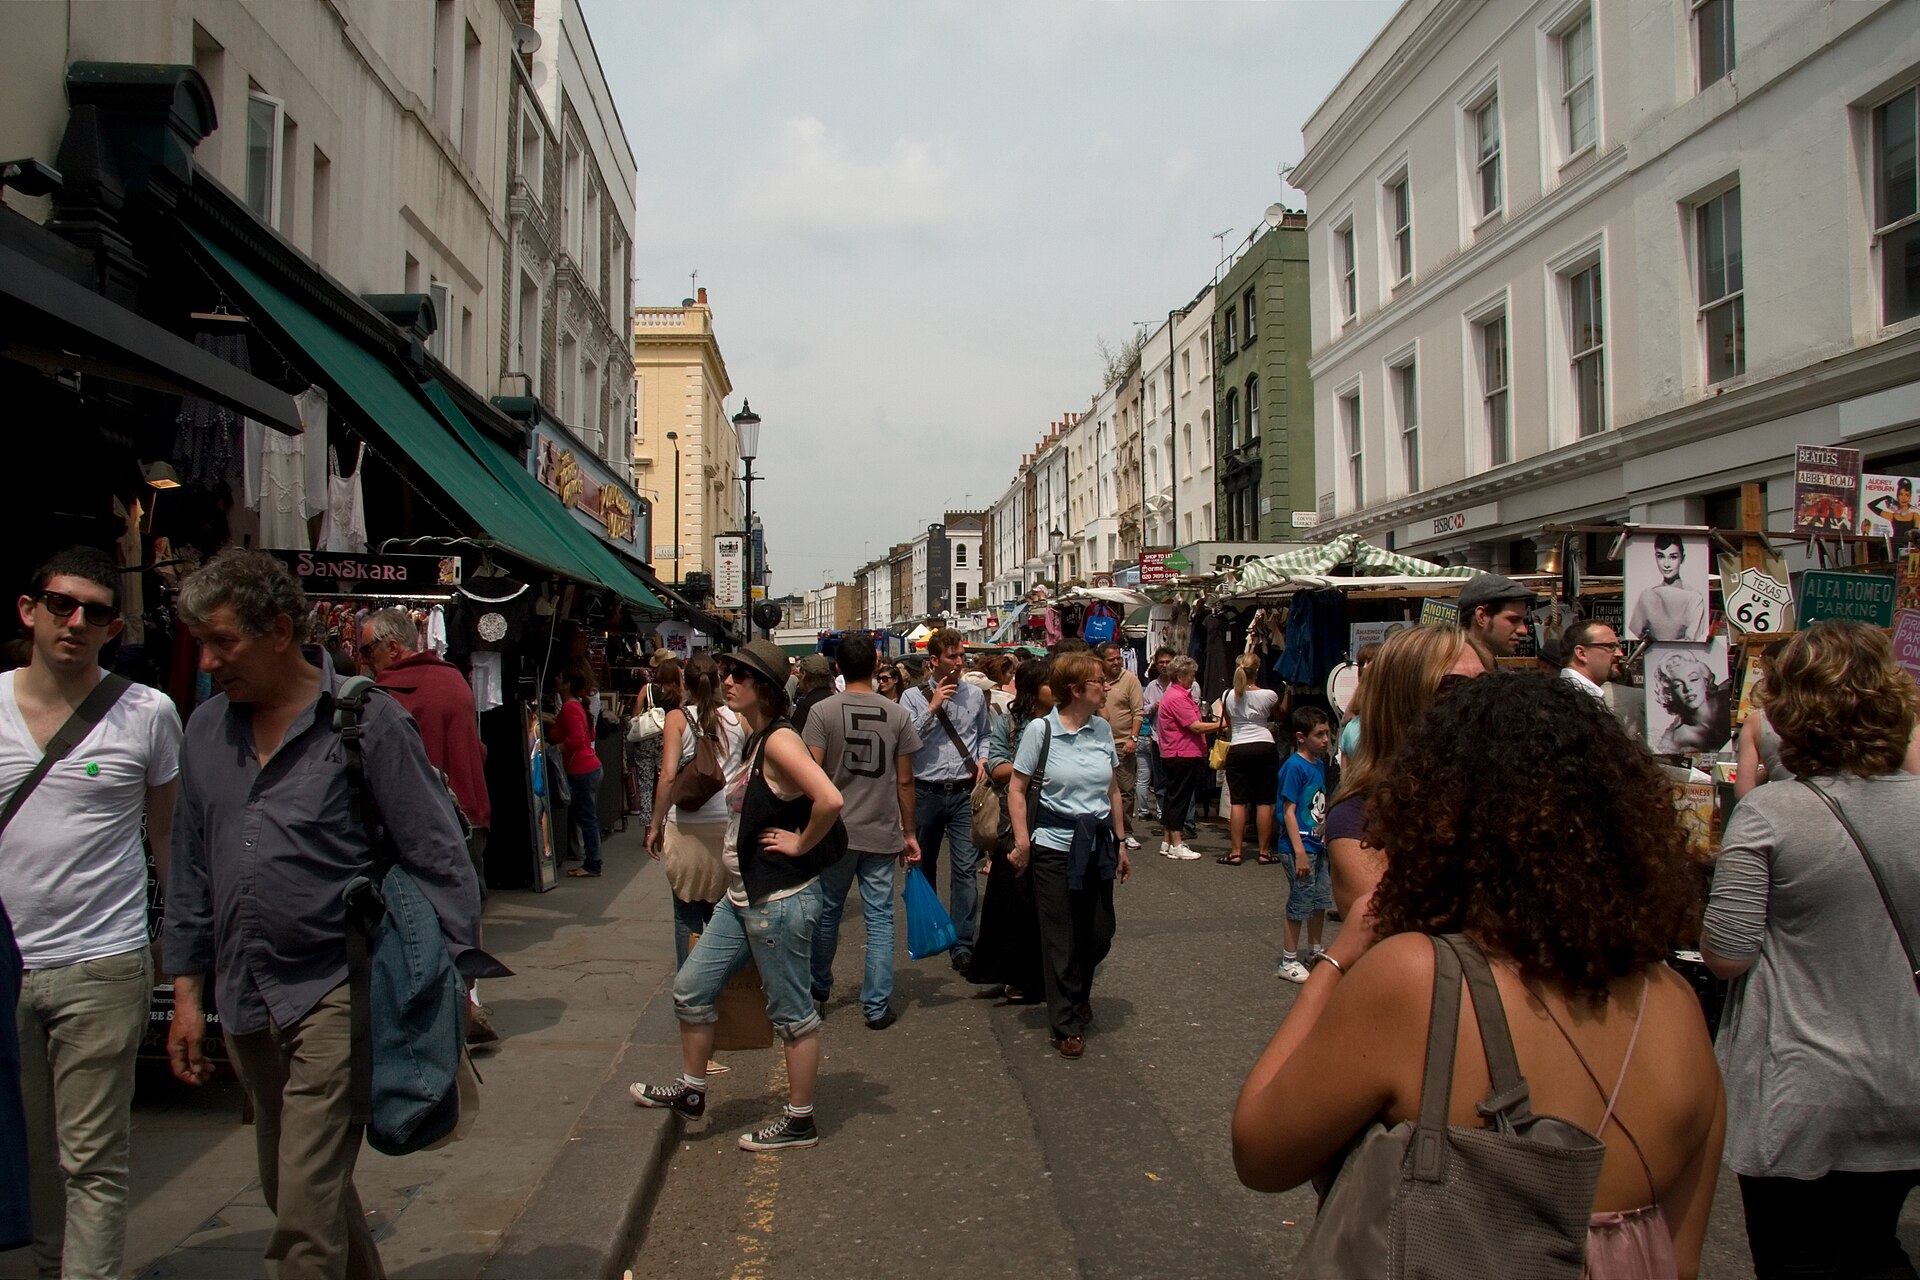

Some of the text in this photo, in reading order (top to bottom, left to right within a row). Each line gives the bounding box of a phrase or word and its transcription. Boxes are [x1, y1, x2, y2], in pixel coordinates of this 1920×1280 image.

[1799, 450, 1838, 464] BEATLES
[1799, 472, 1854, 487] ABBEY ROAD
[1865, 484, 1895, 492] HEPBURN
[1433, 515, 1454, 534] HSBC
[1752, 577, 1782, 599] TEXAS
[1805, 579, 1892, 603] ALFA ROMEO
[1751, 594, 1771, 608] US
[1815, 600, 1878, 617] PARKING
[1424, 602, 1457, 620] ANOTHE
[1595, 605, 1623, 615] TRIUMP
[1737, 603, 1771, 632] 66
[1595, 615, 1623, 625] PARKIN
[1897, 630, 1920, 644] PAR
[1902, 644, 1920, 659] ON
[842, 703, 887, 778] 5
